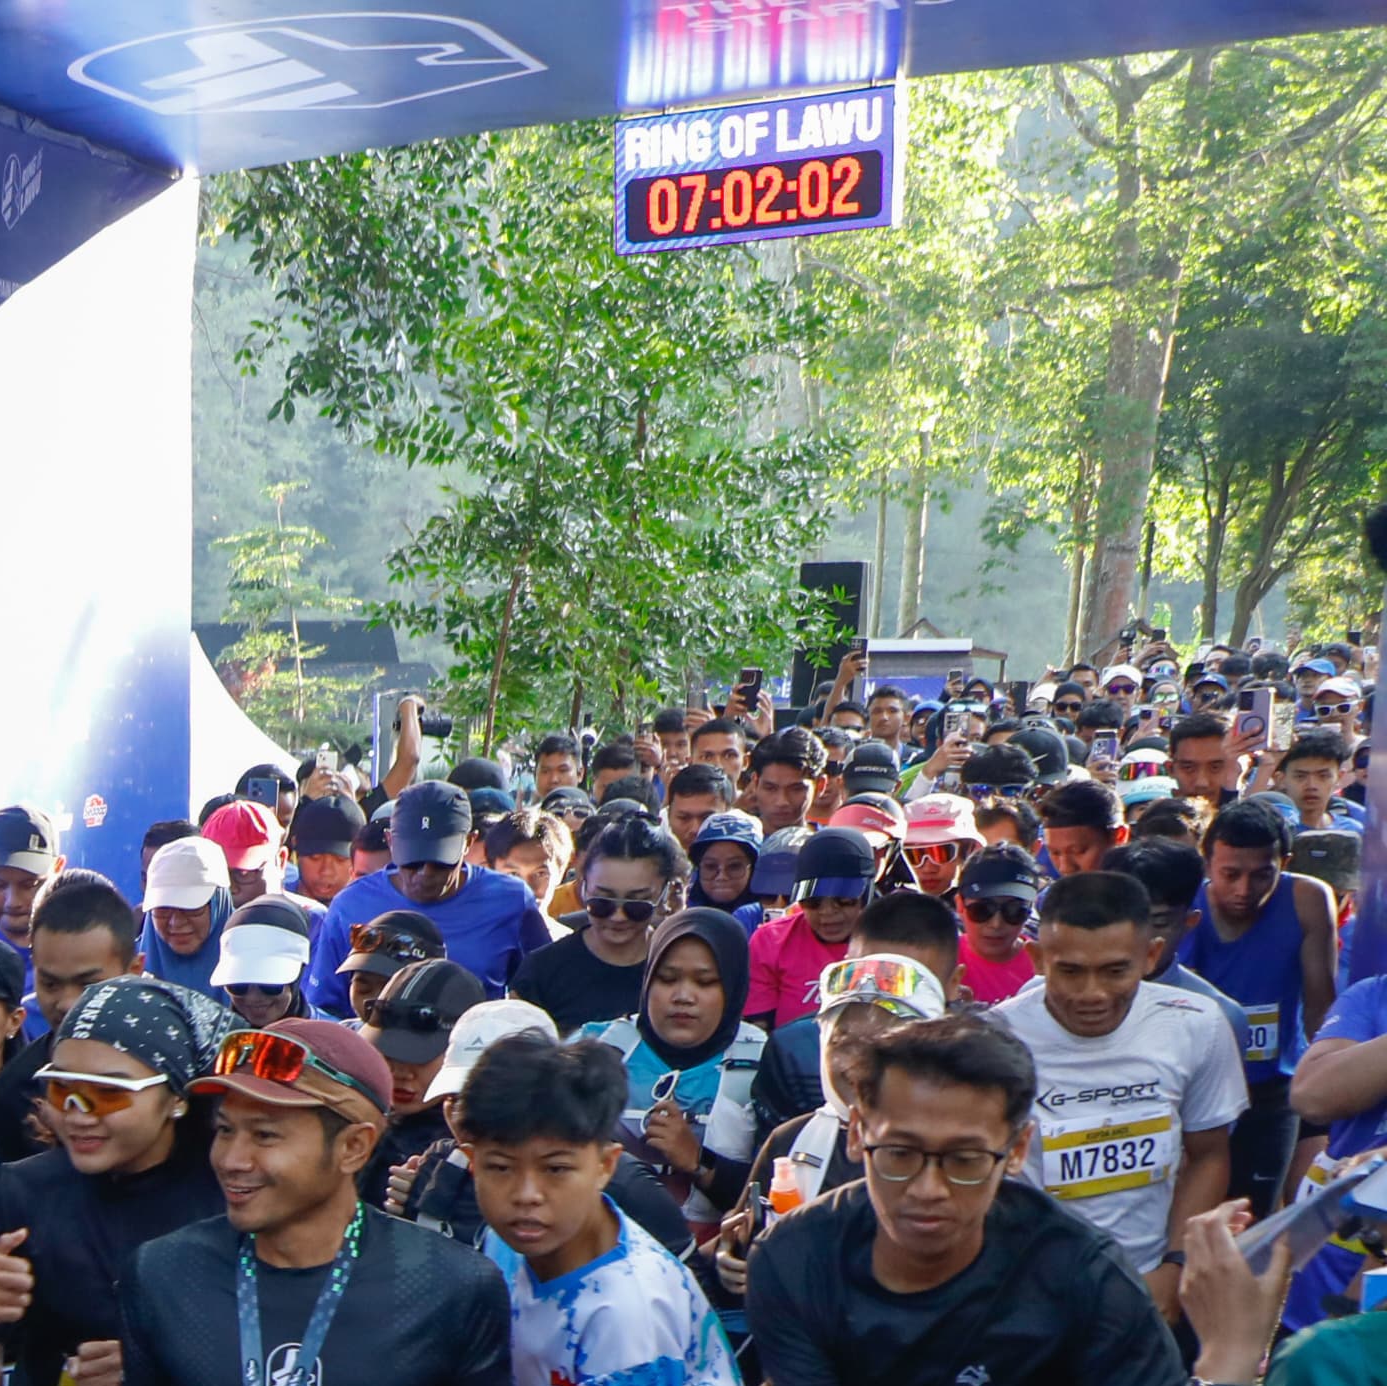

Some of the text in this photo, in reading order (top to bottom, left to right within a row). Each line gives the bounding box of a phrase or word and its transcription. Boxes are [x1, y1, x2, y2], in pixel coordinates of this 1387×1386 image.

[625, 97, 883, 171] RING OF LAWU
[647, 156, 862, 236] 07:02:02
[1060, 1138, 1156, 1181] M7832
